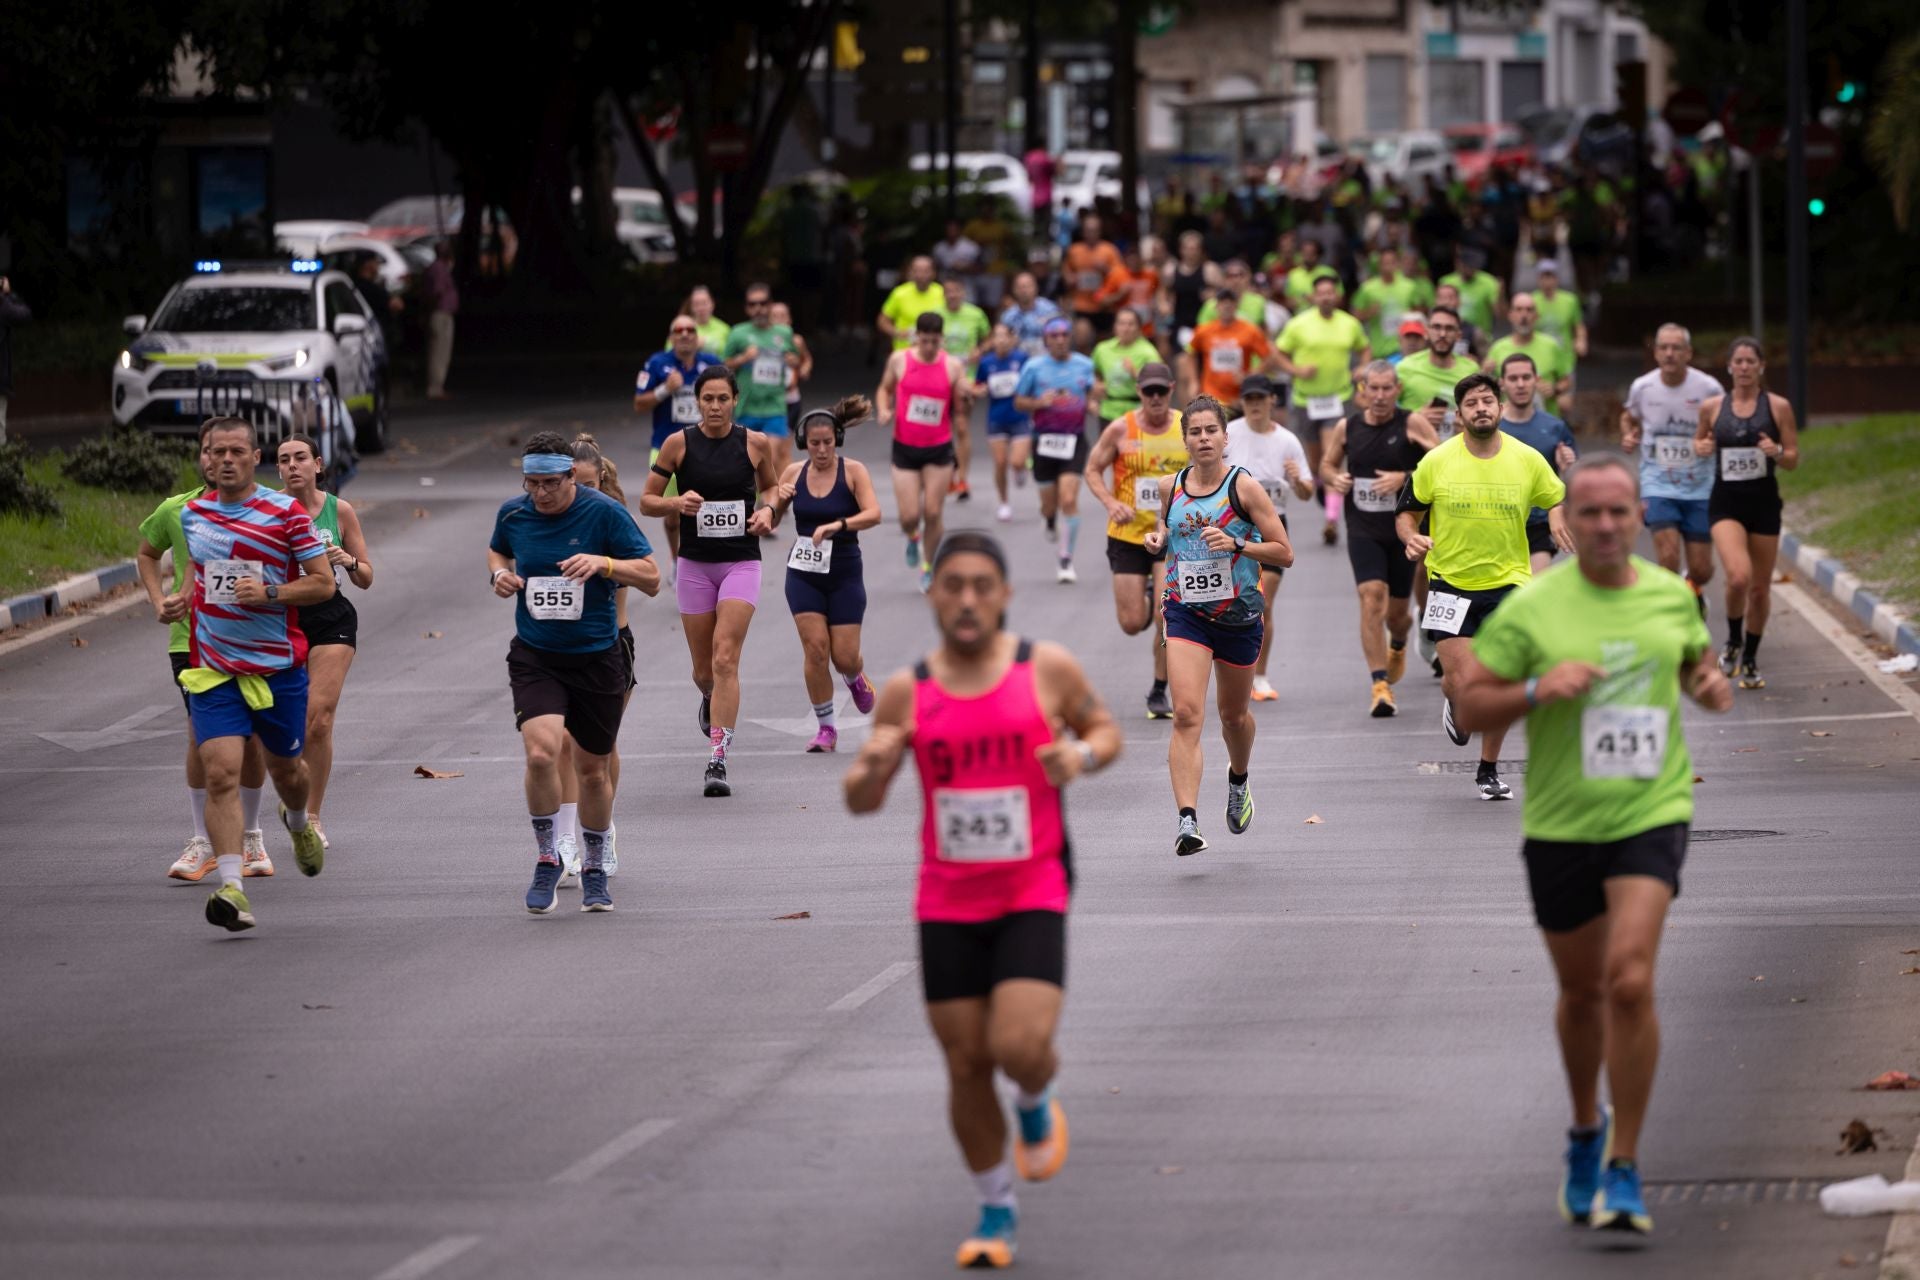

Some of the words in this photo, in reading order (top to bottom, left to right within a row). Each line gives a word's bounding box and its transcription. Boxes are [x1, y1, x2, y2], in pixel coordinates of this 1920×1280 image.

[1728, 459, 1759, 471] 255
[1452, 487, 1517, 501] BETTER
[703, 513, 738, 526] 360
[795, 548, 823, 563] 259
[212, 575, 252, 591] 73
[1185, 573, 1223, 590] 293
[533, 591, 573, 606] 555
[1429, 605, 1456, 620] 909
[1598, 731, 1657, 755] 431
[948, 814, 1012, 842] 243
